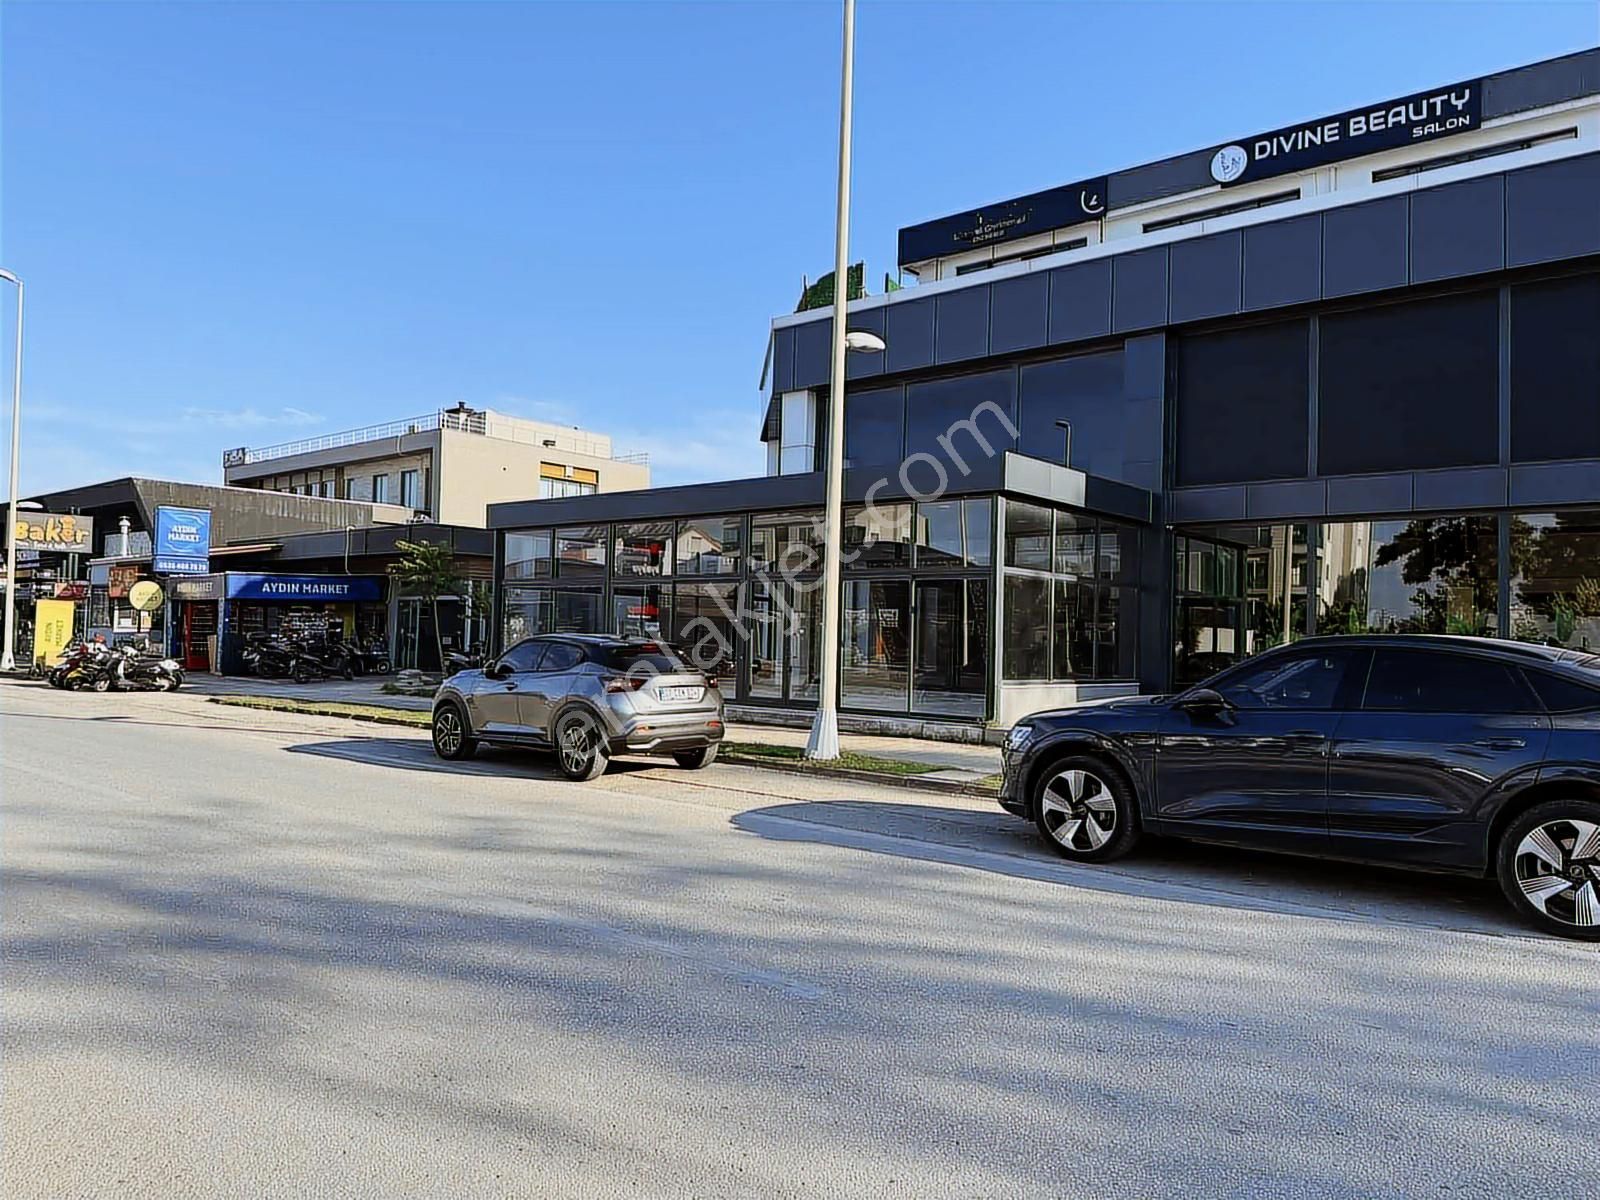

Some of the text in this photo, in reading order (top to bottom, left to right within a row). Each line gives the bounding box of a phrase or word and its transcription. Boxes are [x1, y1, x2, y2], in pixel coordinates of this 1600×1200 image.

[1254, 88, 1470, 161] DIVINE BEAUTY
[1412, 114, 1470, 138] SALON
[15, 515, 90, 544] Baker
[262, 582, 350, 594] AYDIN MARKET
